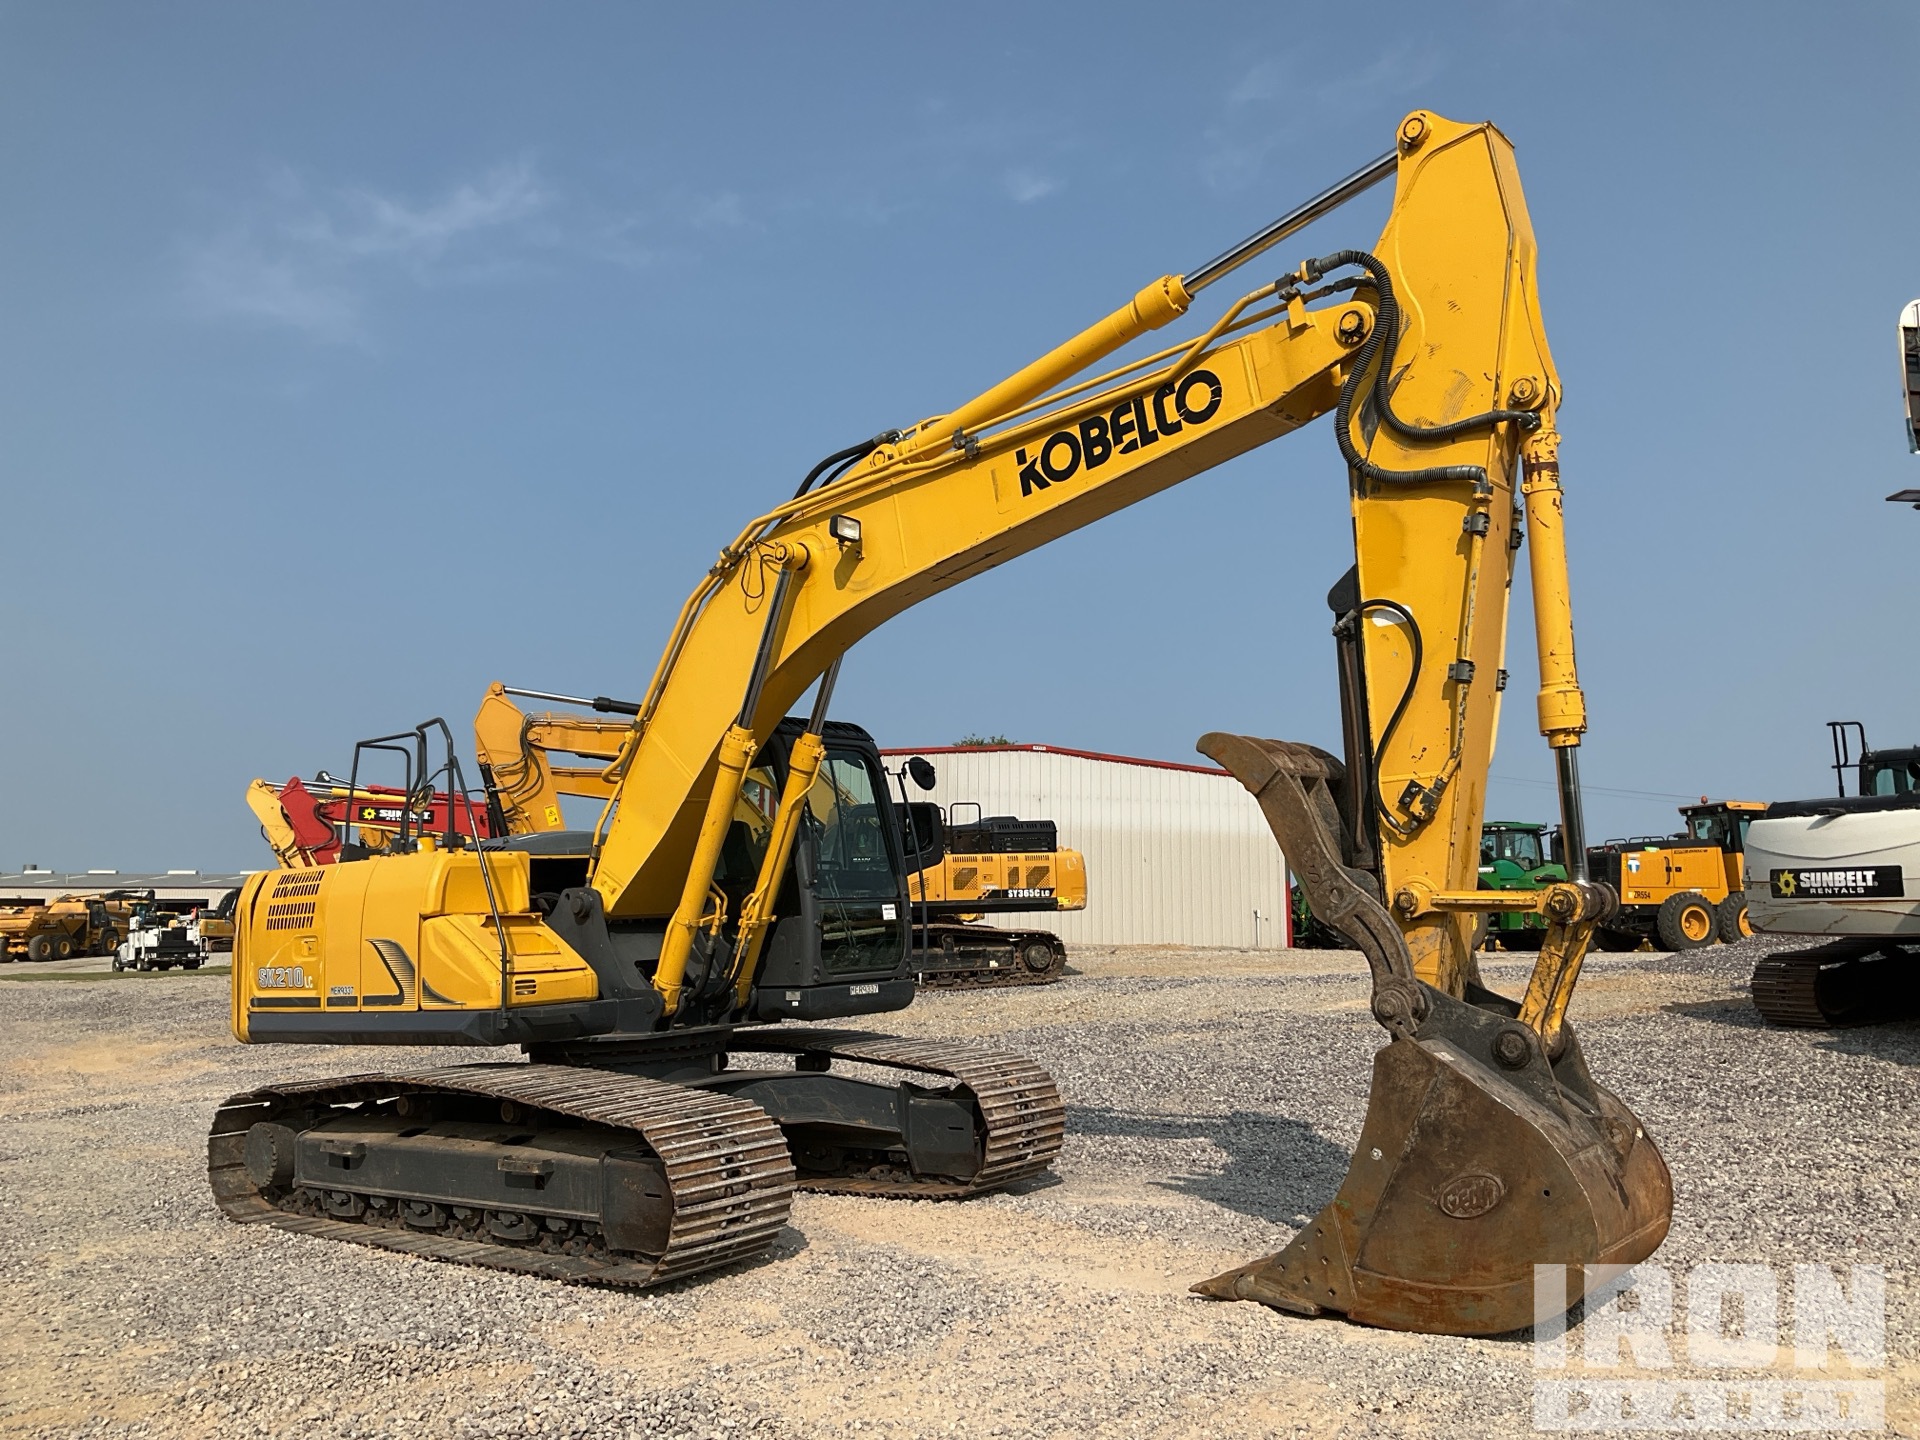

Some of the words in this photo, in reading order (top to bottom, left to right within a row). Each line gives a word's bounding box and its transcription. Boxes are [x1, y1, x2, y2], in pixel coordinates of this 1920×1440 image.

[1015, 369, 1222, 498] KOBELCO
[1799, 870, 1876, 888] SUNBELT
[1809, 886, 1865, 894] RENTALS
